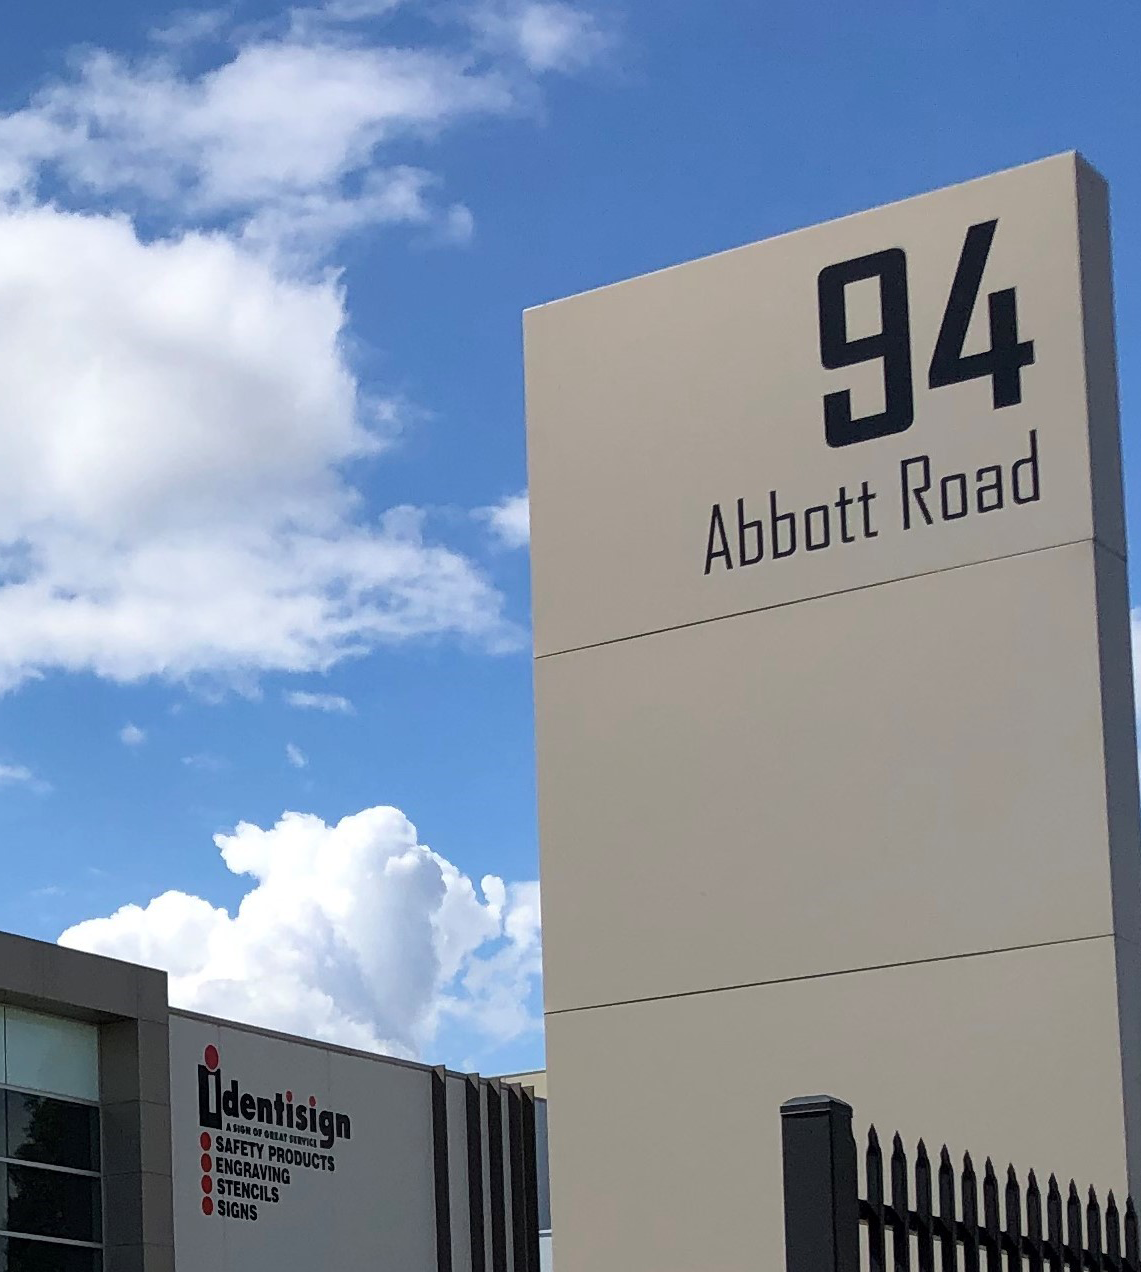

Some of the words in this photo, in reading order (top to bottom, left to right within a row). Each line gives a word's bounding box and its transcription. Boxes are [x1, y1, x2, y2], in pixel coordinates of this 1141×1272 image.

[818, 219, 1034, 448] 94
[704, 482, 878, 575] Abbott
[901, 430, 1040, 531] Road
[226, 1123, 231, 1132] A
[233, 1125, 251, 1136] SIGN
[253, 1127, 262, 1137] OF
[264, 1130, 287, 1142] GREAT
[289, 1135, 317, 1148] SERVICE
[216, 1136, 264, 1159] SAFETY
[268, 1145, 335, 1171] PRODUCTS
[216, 1157, 290, 1184] ENGRAVING
[217, 1178, 279, 1203] STENCILS
[218, 1200, 257, 1221] SIGNS
